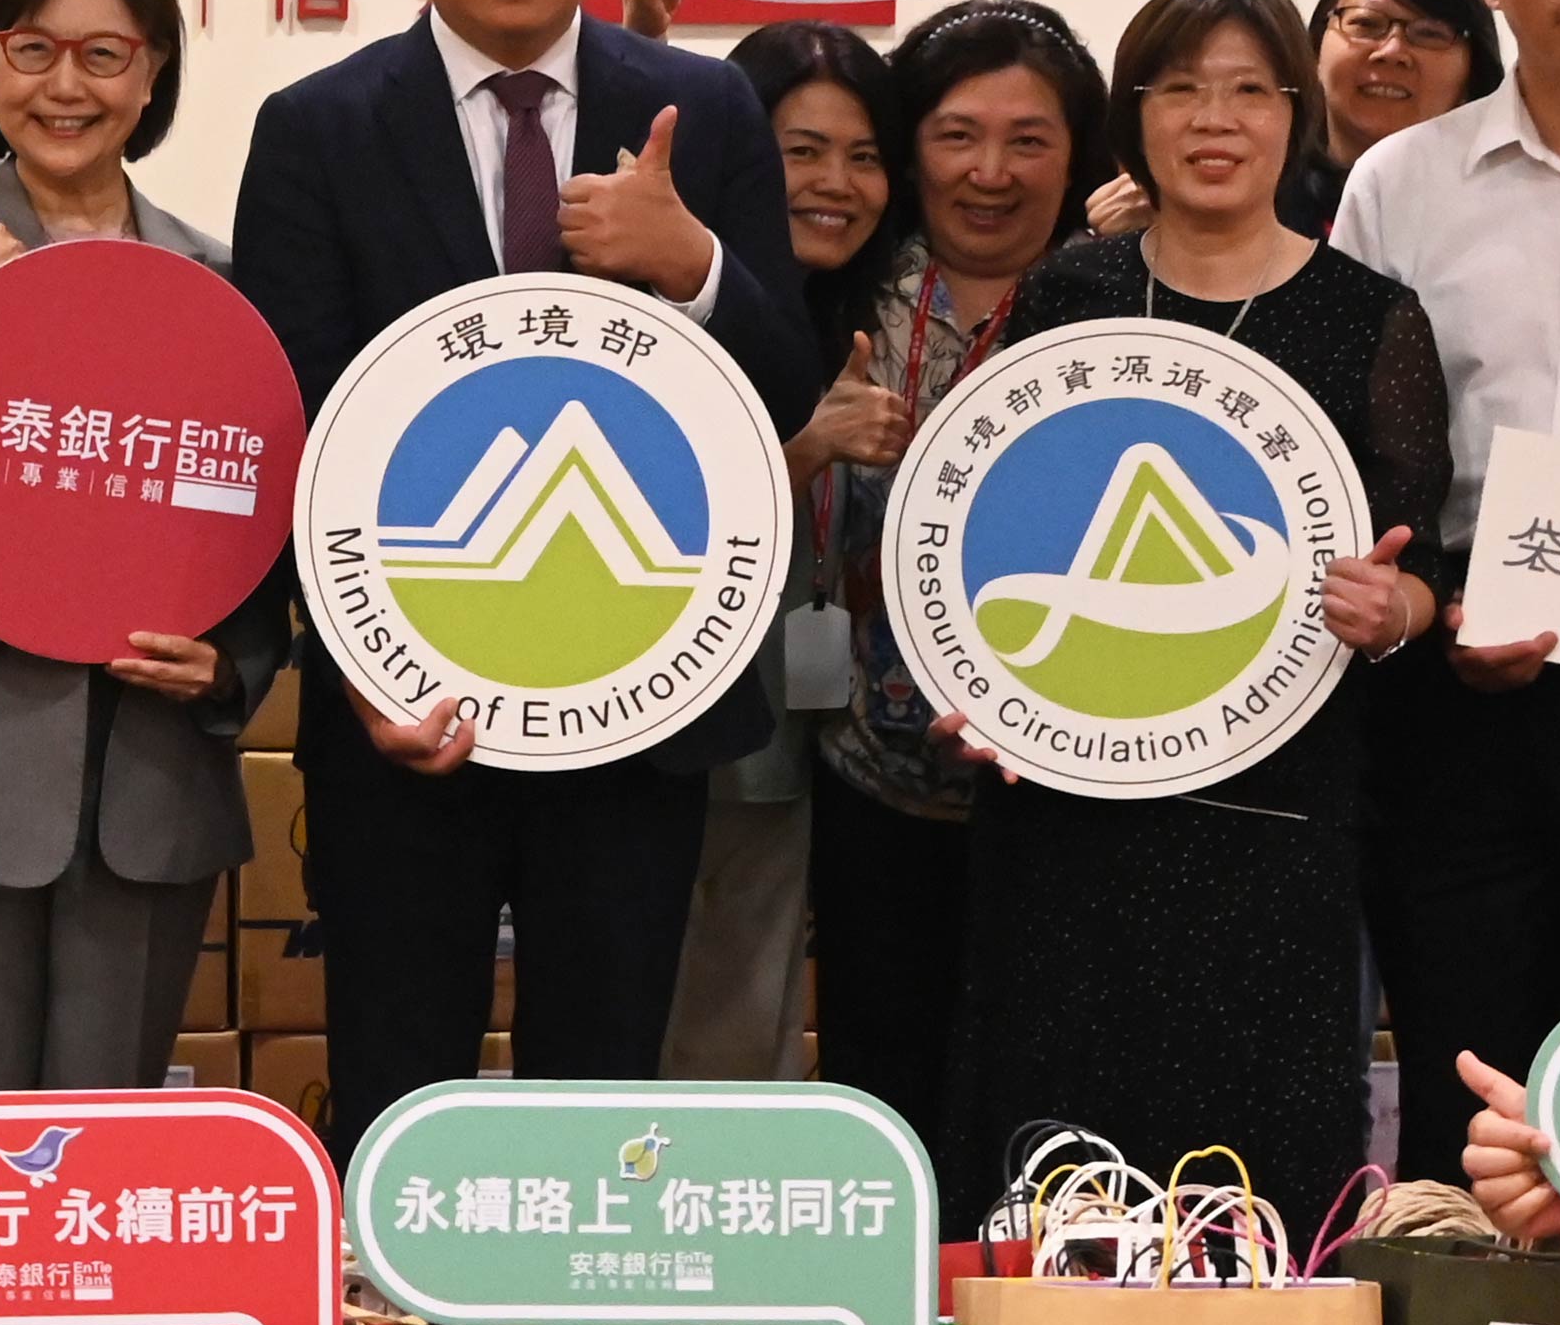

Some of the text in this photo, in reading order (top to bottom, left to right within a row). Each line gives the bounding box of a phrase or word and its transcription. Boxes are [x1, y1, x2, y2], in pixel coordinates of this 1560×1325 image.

[435, 304, 661, 369] 環境部
[179, 418, 265, 457] EnTie
[934, 353, 1302, 506] 環境部資源循環署
[19, 459, 79, 493] 專業
[104, 470, 164, 503] 信賴
[175, 450, 259, 484] Bank
[326, 526, 764, 740] Ministry of Environment
[917, 471, 1335, 766] Resource Circulation Administration
[53, 1184, 297, 1245] 永續前行
[393, 1177, 895, 1236] 永續路上 你我同行
[73, 1260, 113, 1275] EnTie
[73, 1273, 112, 1287] Bank
[569, 1251, 672, 1276] 安泰銀行
